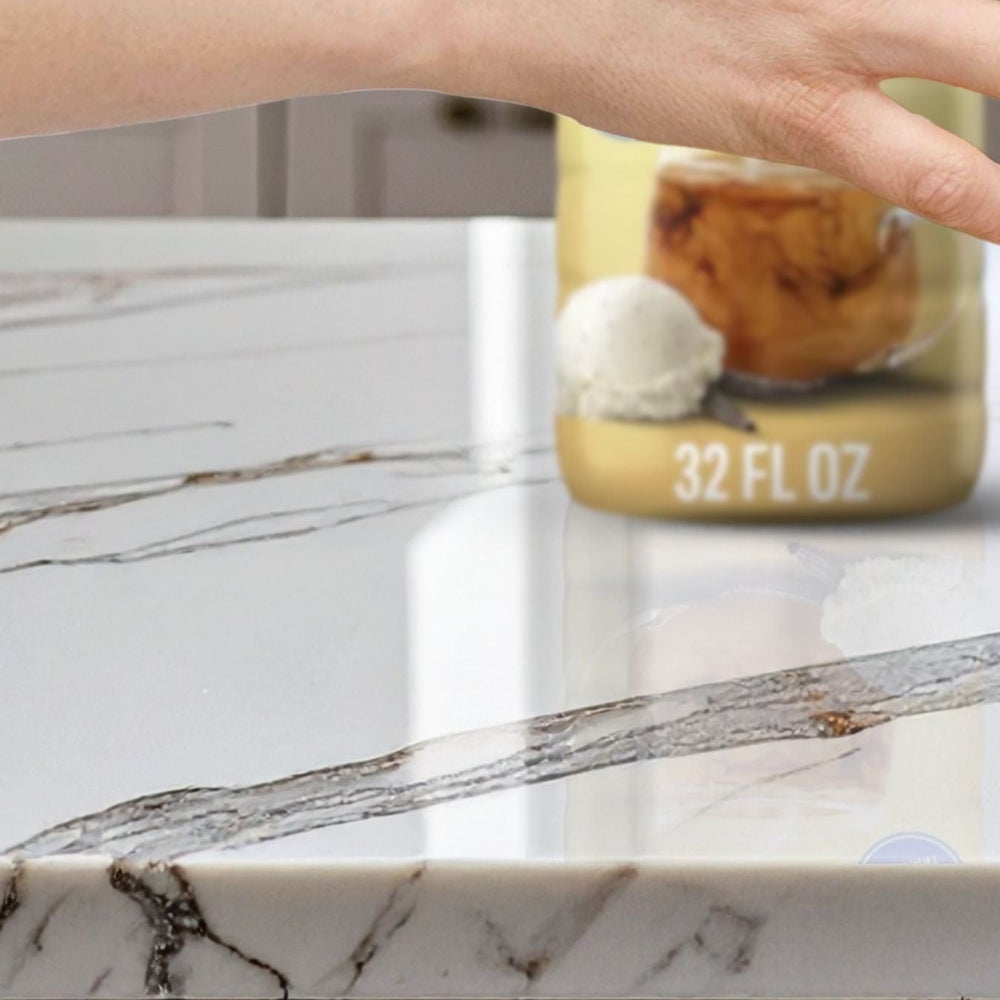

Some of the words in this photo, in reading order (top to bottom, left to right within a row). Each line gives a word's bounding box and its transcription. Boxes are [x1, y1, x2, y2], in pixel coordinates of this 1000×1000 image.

[673, 440, 730, 503] 32
[742, 440, 797, 502] FL
[808, 440, 874, 502] OZ
